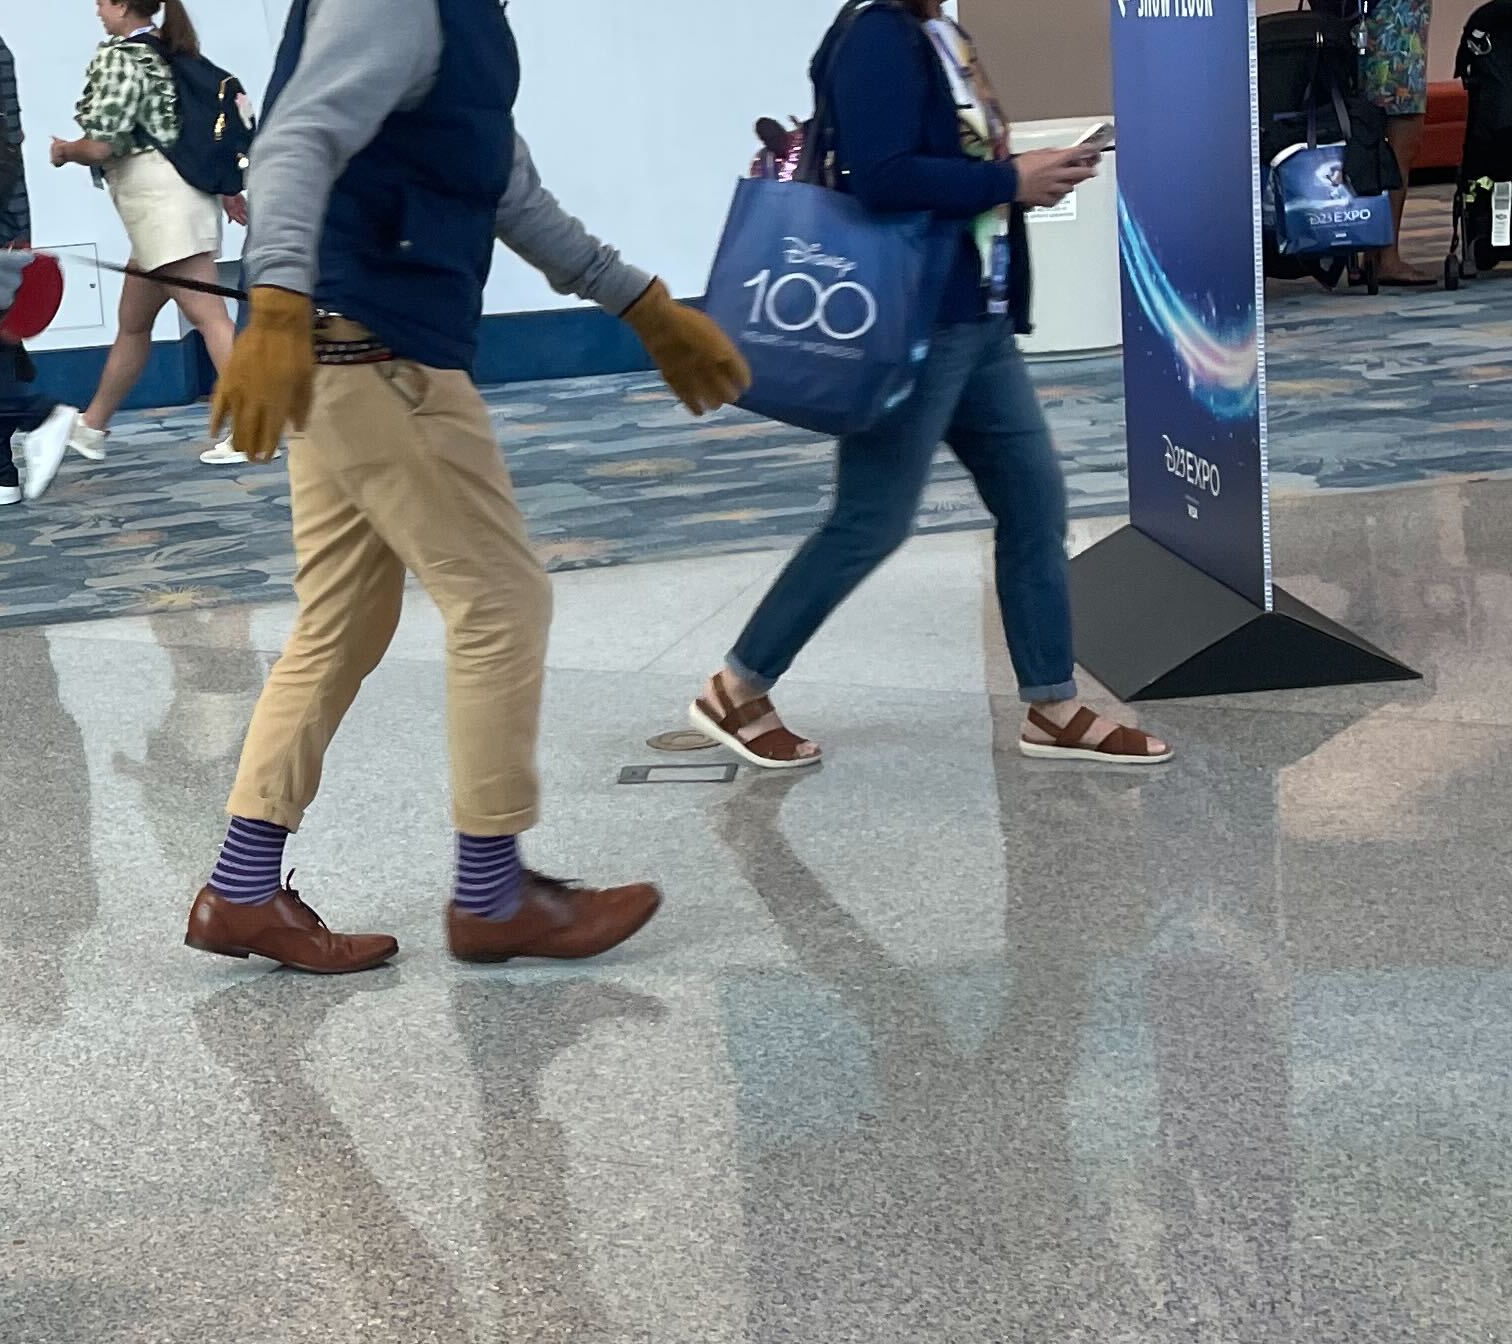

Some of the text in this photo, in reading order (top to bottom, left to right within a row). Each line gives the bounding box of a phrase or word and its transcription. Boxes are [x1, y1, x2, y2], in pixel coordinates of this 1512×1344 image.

[1333, 208, 1371, 223] EXPO
[743, 269, 876, 340] 100
[1162, 434, 1220, 496] D23 EXPO
